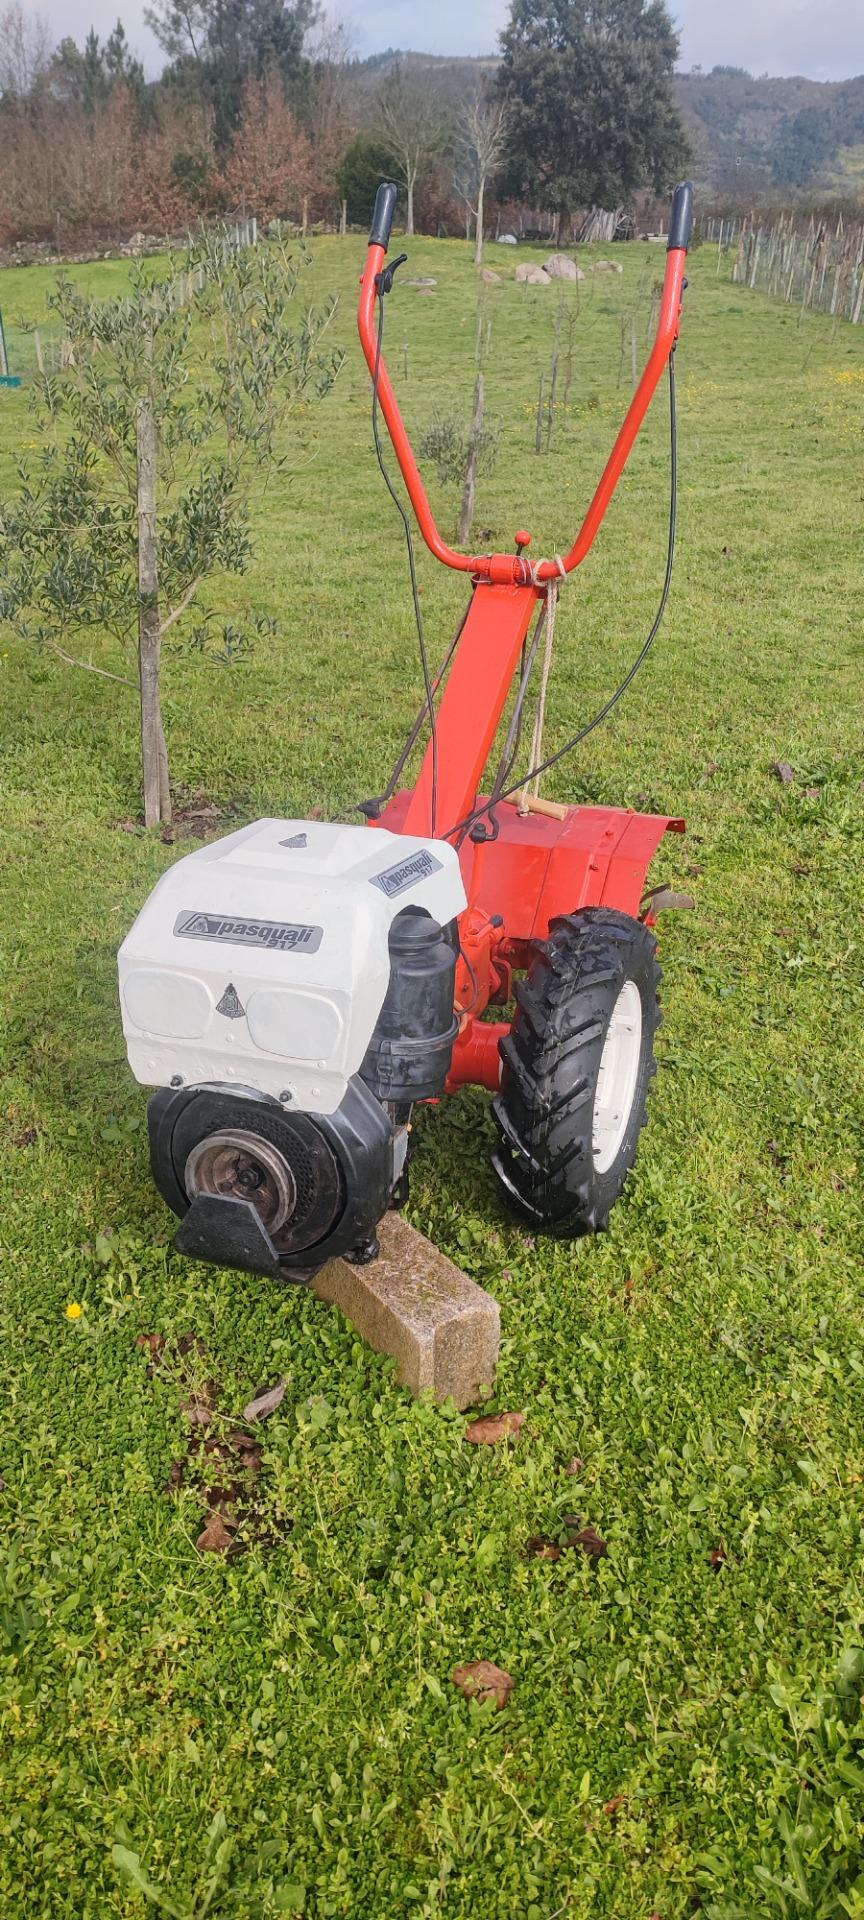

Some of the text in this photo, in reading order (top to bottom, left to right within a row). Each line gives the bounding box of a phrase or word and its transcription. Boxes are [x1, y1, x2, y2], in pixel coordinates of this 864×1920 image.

[394, 851, 433, 884] pasquali
[420, 864, 433, 877] 917
[217, 921, 314, 943] pasquali
[265, 939, 298, 950] 917
